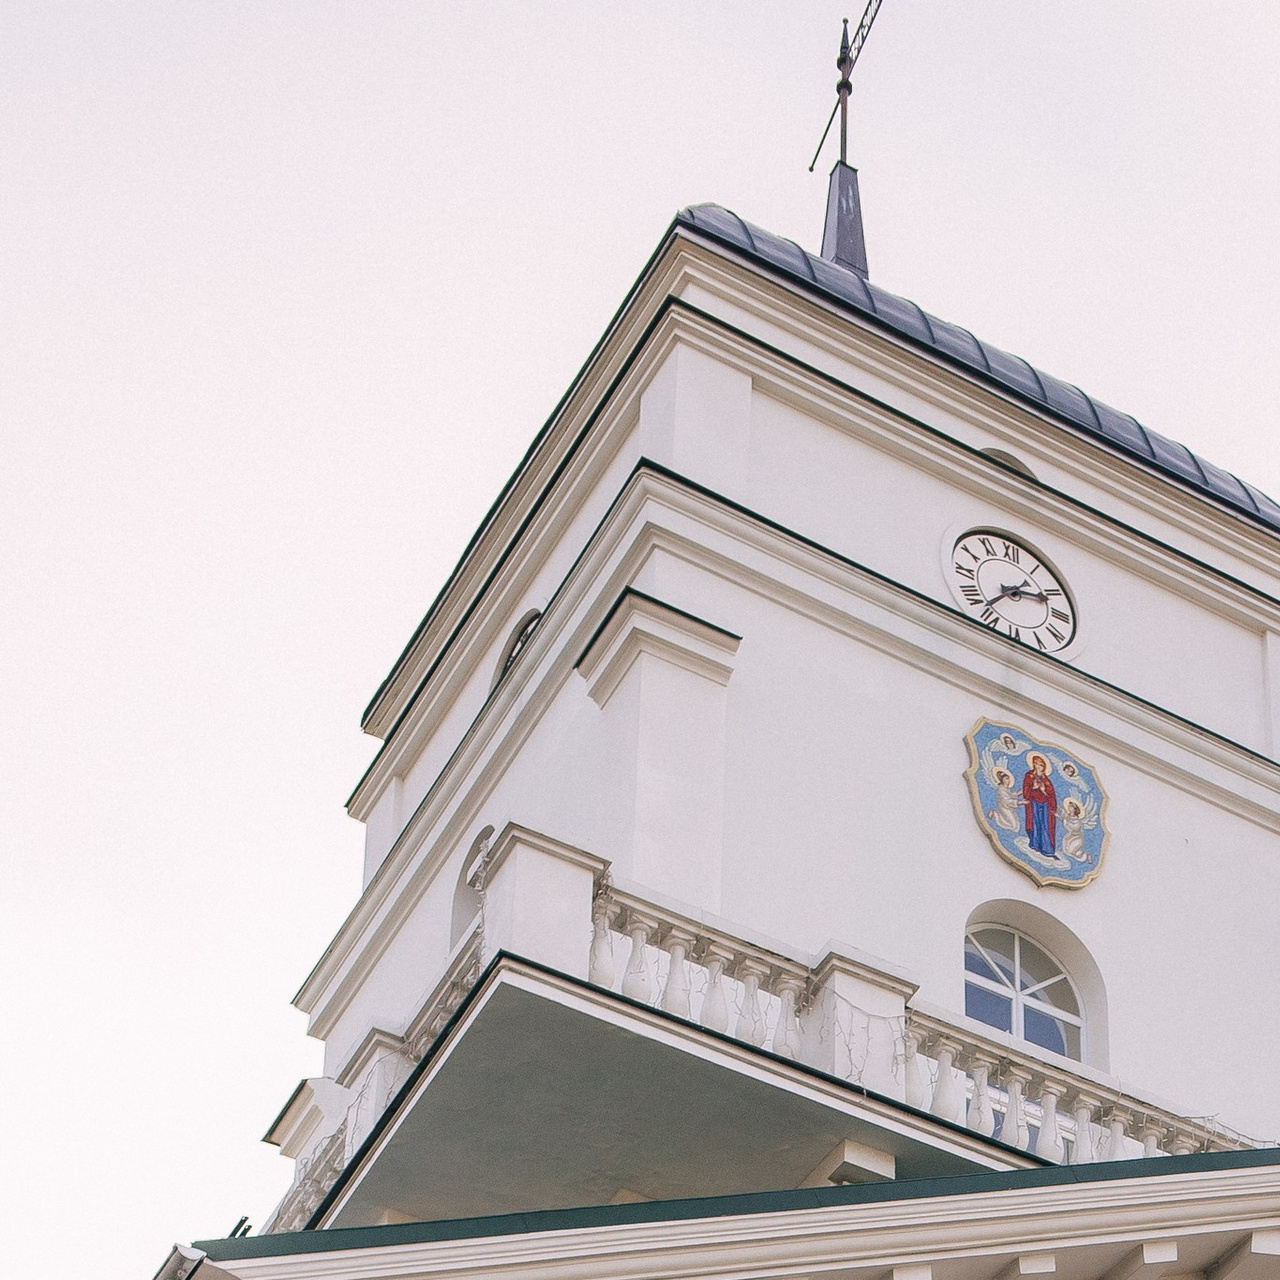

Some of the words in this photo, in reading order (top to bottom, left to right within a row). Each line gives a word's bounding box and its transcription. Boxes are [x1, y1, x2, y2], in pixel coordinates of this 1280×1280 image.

[960, 543, 981, 563] X
[977, 537, 998, 556] XI
[1002, 541, 1020, 565] XII
[955, 561, 975, 580] IX
[1043, 588, 1062, 596] II
[1050, 606, 1070, 625] III
